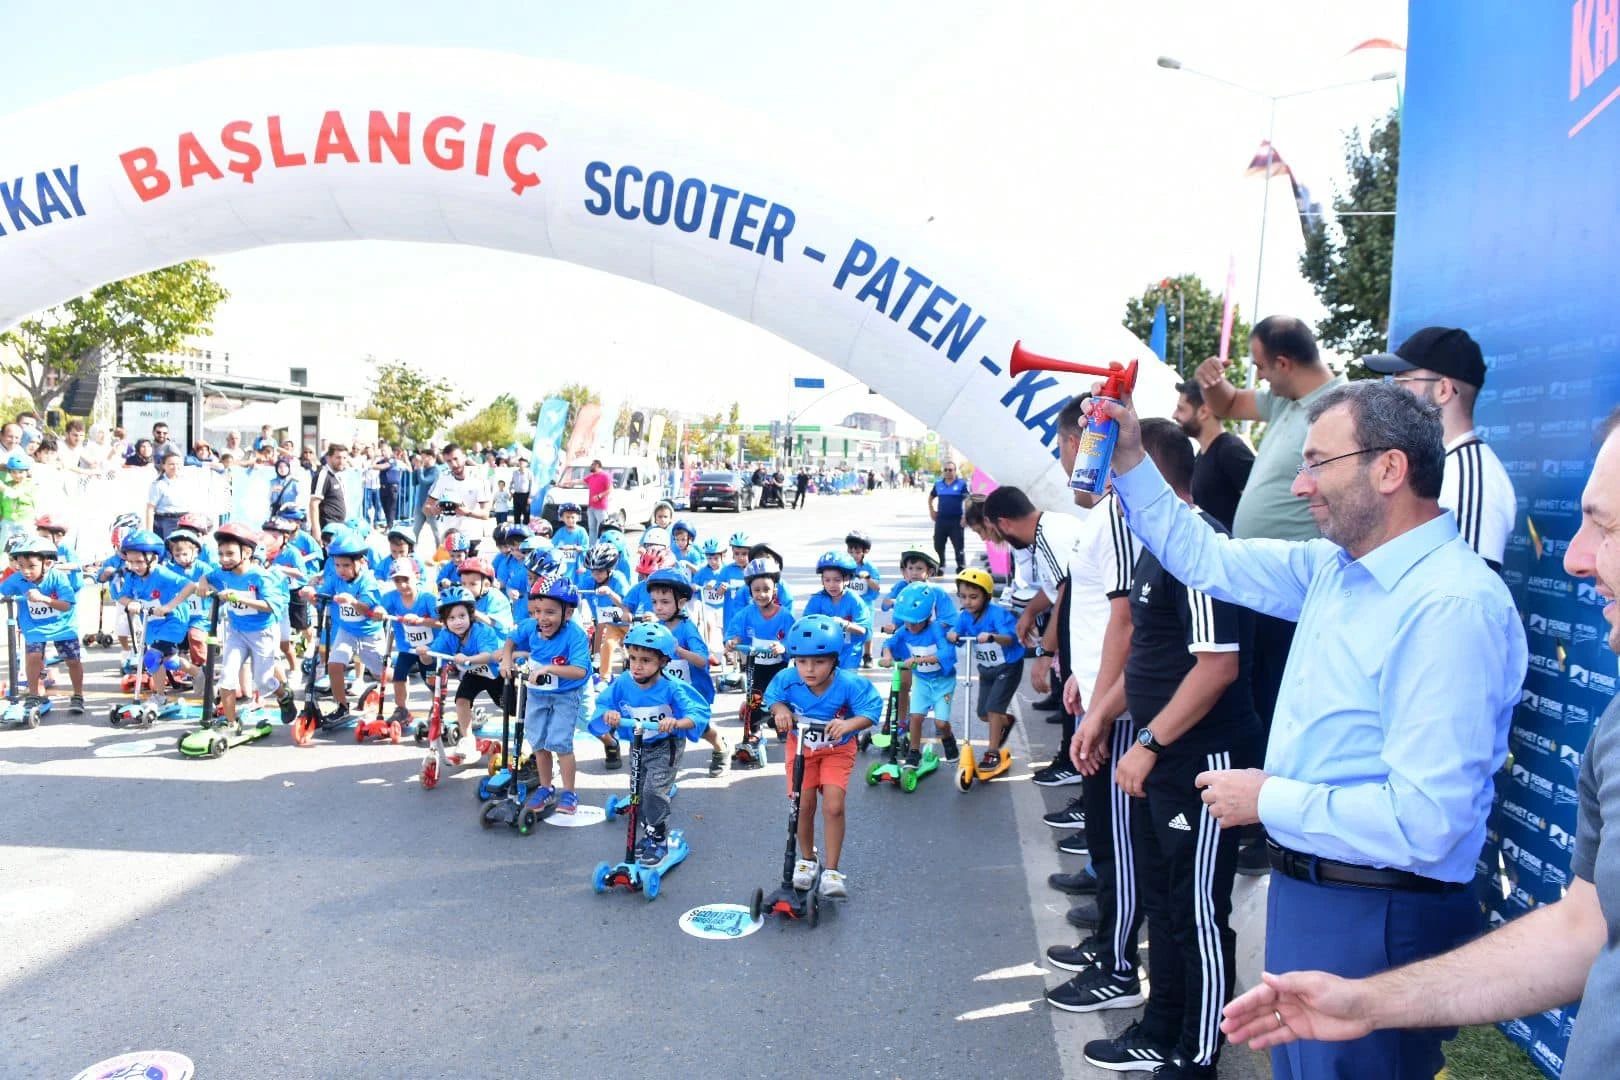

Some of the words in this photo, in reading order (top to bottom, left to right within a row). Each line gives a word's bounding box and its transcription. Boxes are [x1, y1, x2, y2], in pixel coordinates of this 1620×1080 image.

[0, 164, 87, 236] KAY
[119, 110, 548, 203] BAŞLANGIÇ
[584, 161, 796, 262] SCOOTER
[833, 239, 987, 363] PATEN
[1000, 370, 1074, 460] KA
